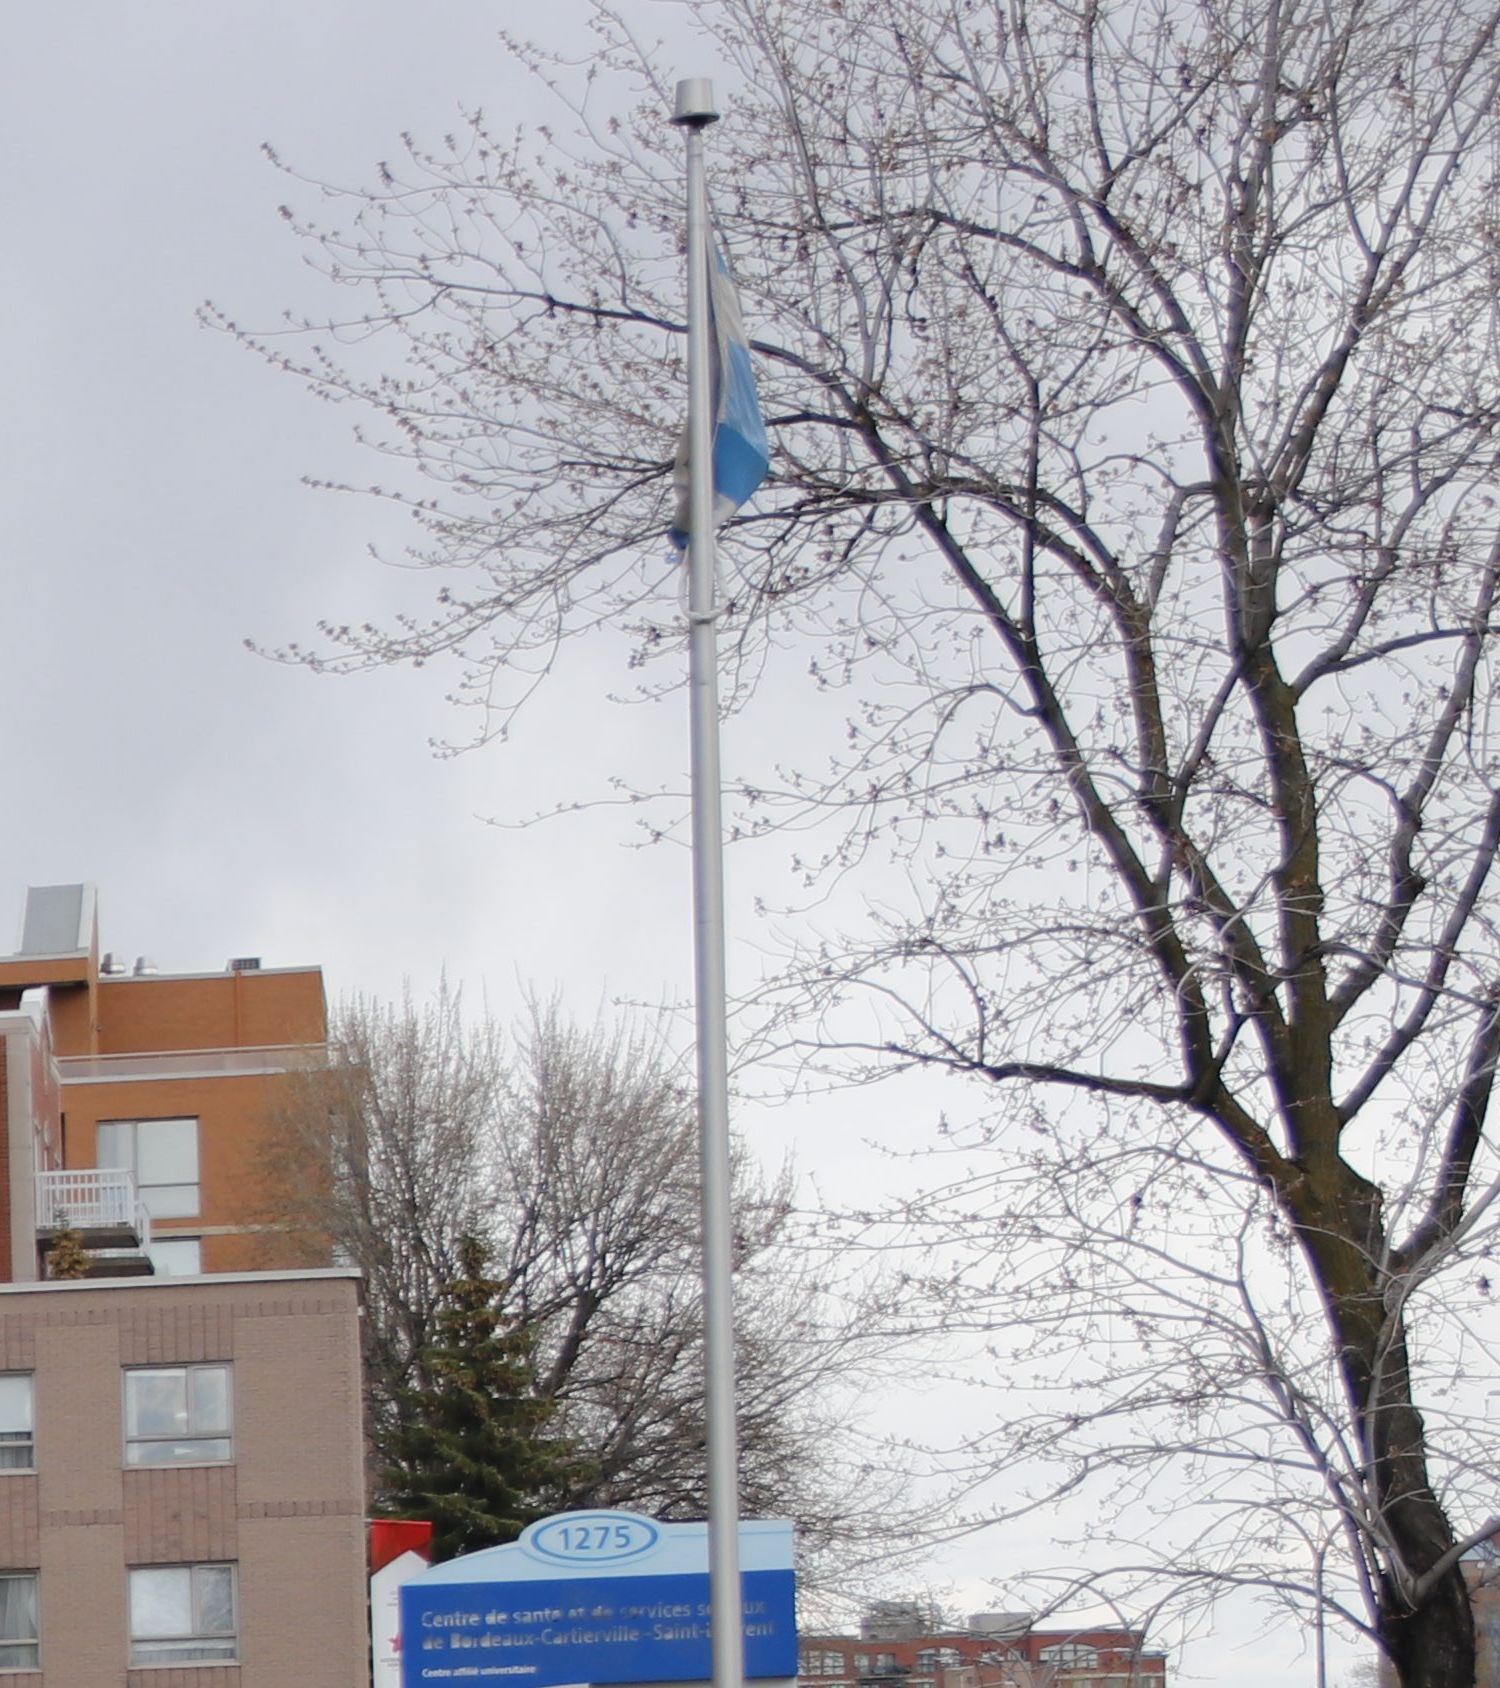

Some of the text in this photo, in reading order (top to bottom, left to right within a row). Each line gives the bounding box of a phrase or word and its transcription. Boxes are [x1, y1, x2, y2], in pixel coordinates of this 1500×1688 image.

[559, 1526, 630, 1550] 1275
[421, 1611, 480, 1627] Centre
[485, 1609, 508, 1625] de
[422, 1632, 444, 1650] de
[421, 1667, 452, 1678] Centre
[480, 1664, 536, 1676] universitaire
